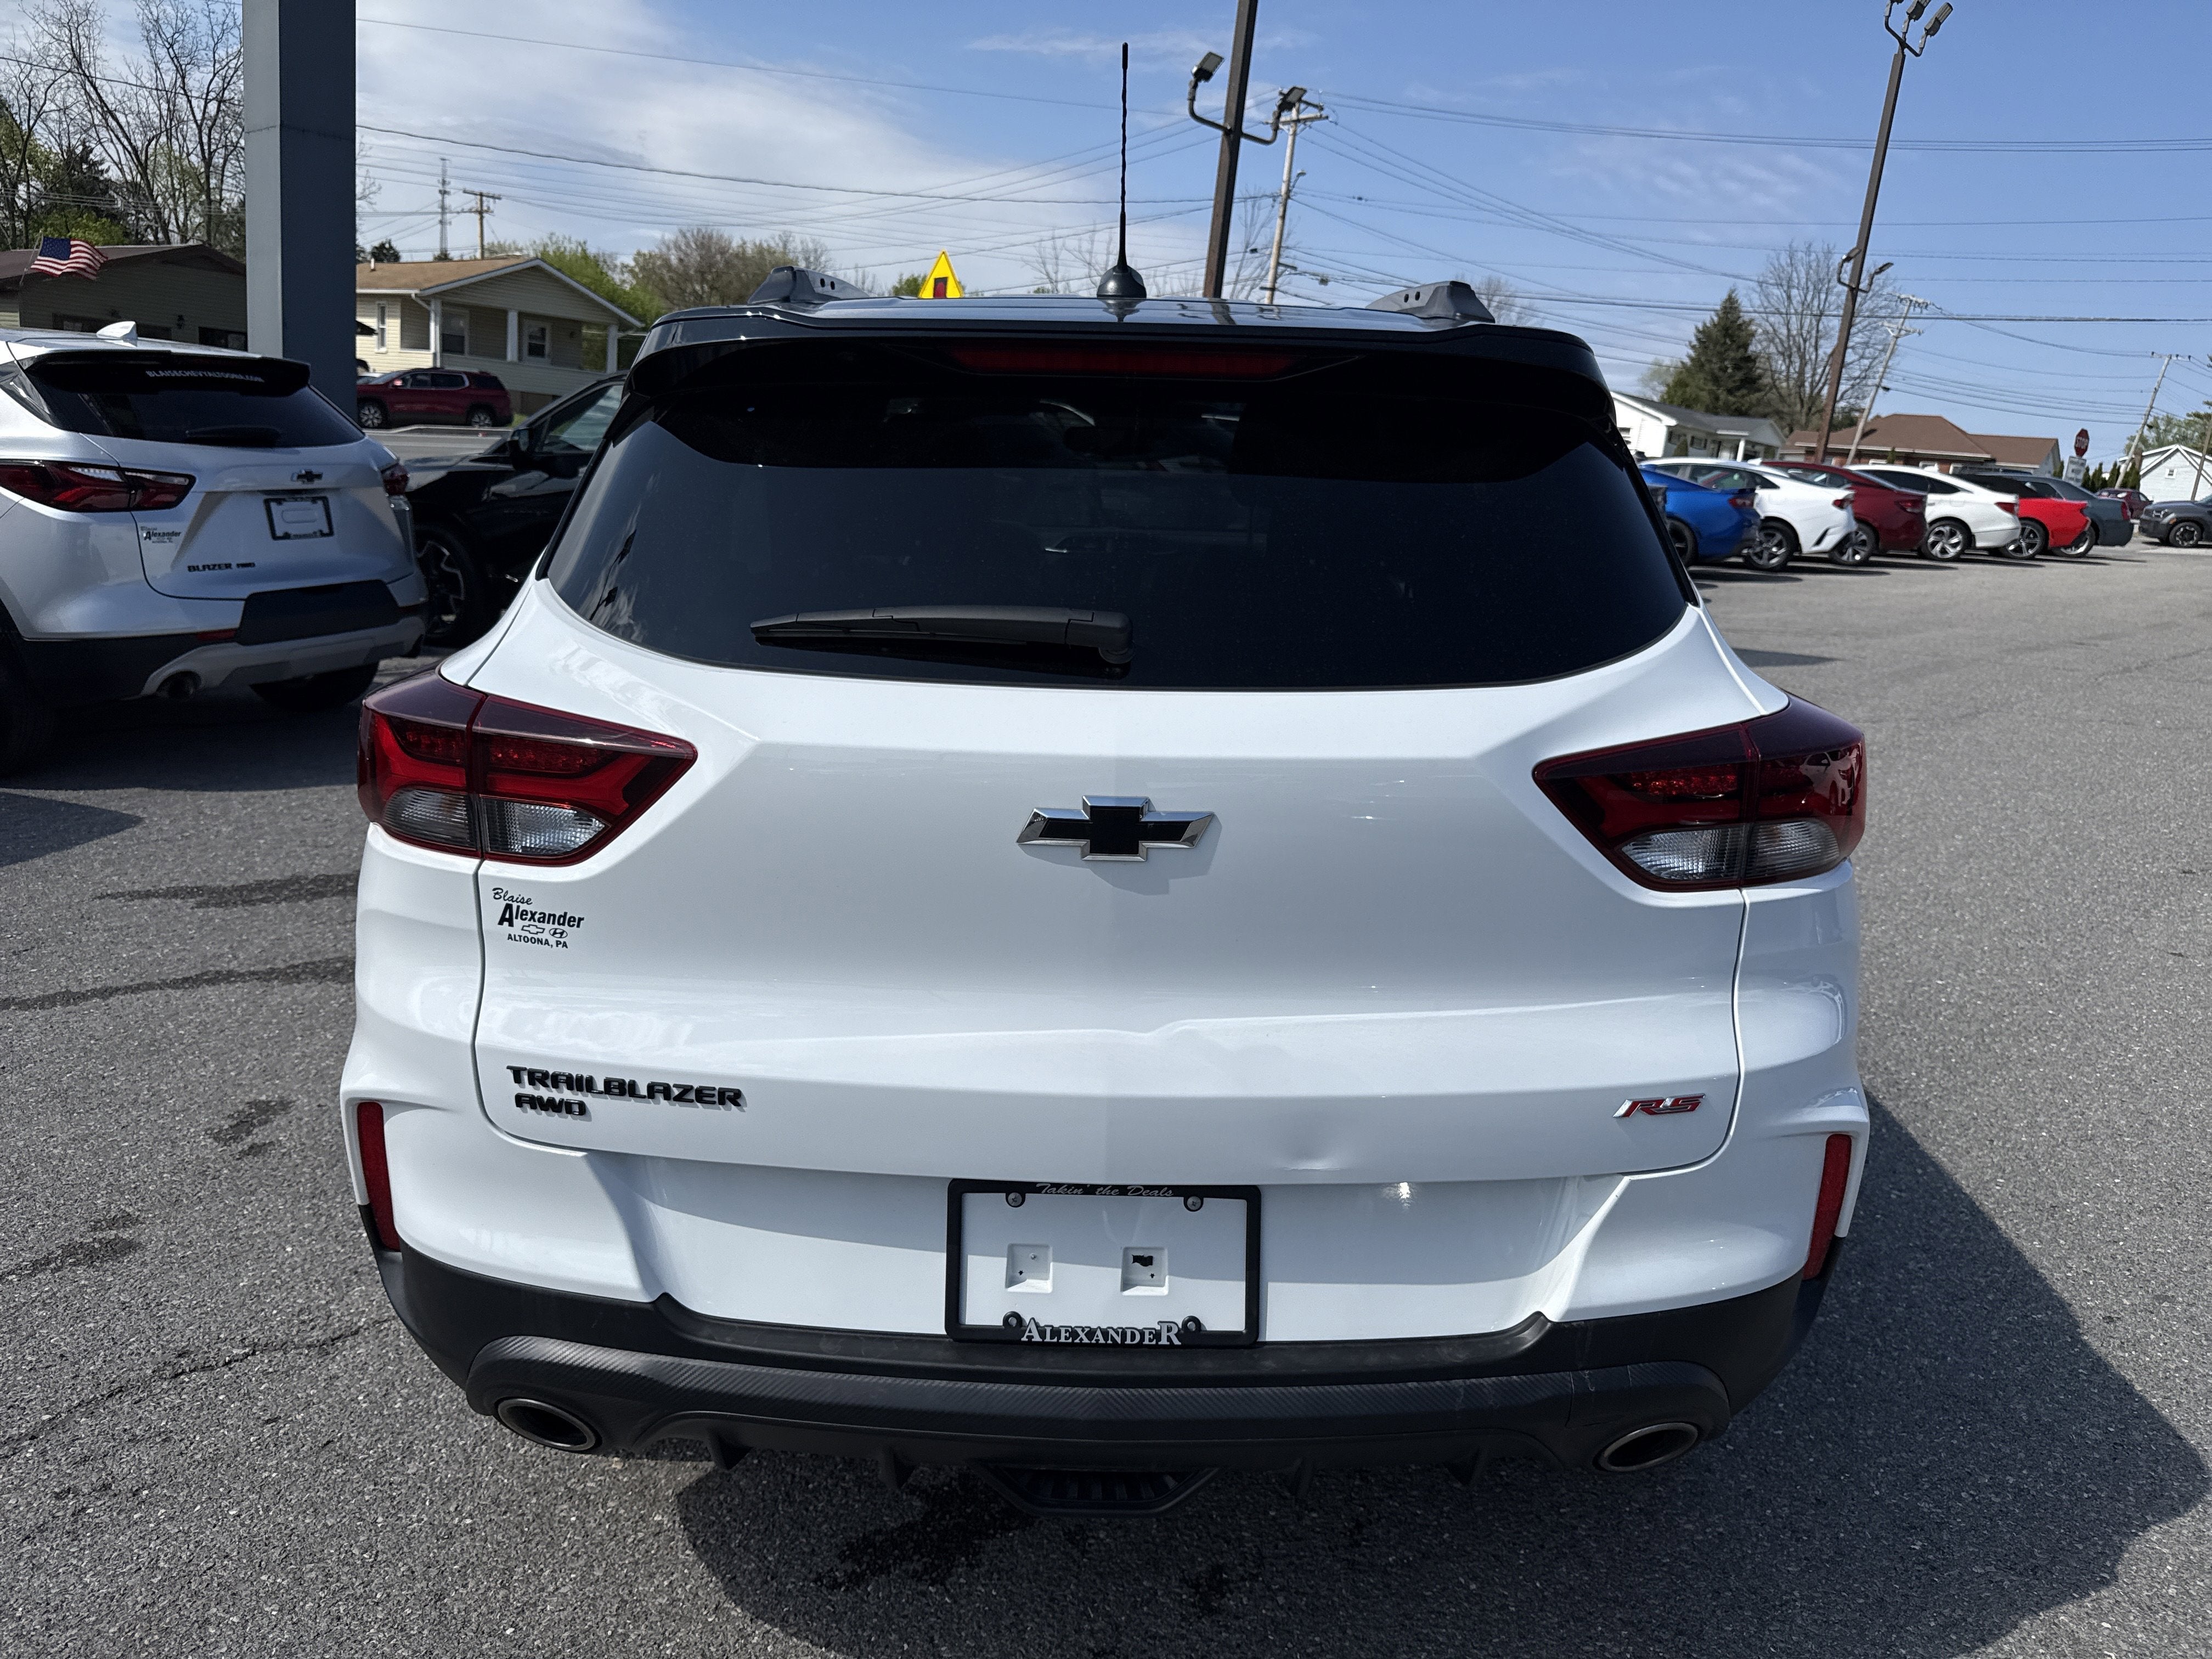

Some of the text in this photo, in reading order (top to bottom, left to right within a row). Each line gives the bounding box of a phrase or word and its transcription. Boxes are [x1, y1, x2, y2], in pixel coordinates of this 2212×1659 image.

[144, 531, 181, 540] Alexander
[188, 563, 232, 572] BLAZER
[492, 887, 533, 905] Blaise
[498, 903, 585, 928] Alexander
[507, 933, 568, 949] ALTOONA, PA
[506, 1065, 742, 1107] TRAILBLAZER
[515, 1092, 586, 1116] AWD
[1613, 1092, 1706, 1118] RS
[1036, 1183, 1175, 1197] Takin' the Deals
[1021, 1318, 1182, 1346] ALEXANDER
